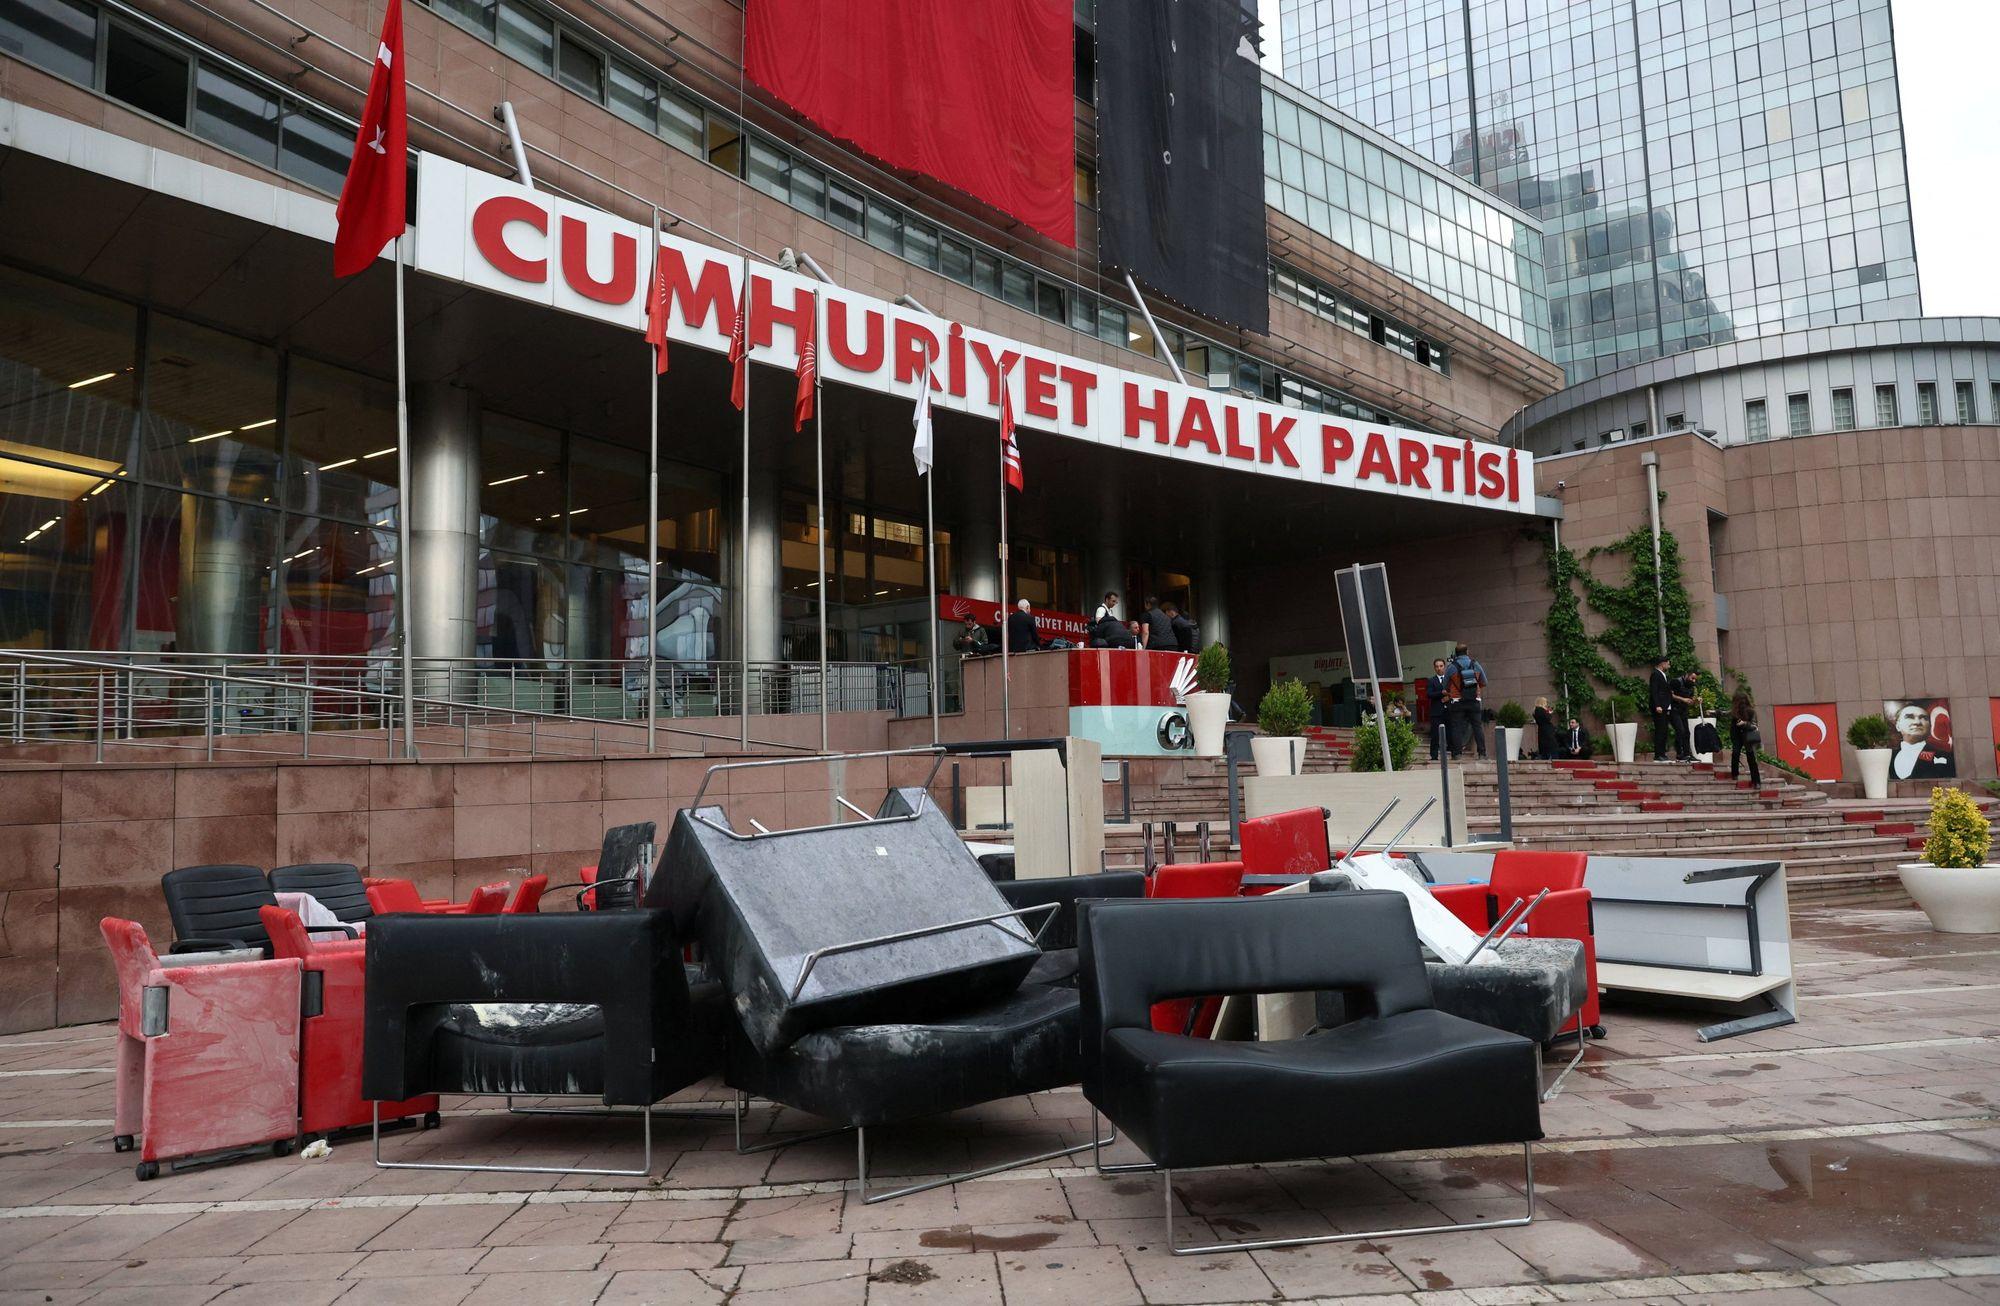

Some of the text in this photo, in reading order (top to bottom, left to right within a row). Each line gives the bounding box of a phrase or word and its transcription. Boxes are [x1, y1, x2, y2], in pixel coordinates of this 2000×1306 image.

[472, 196, 1519, 502] CUMHURİYET HALK PARTİSİ
[994, 610, 1062, 631] CRİYET
